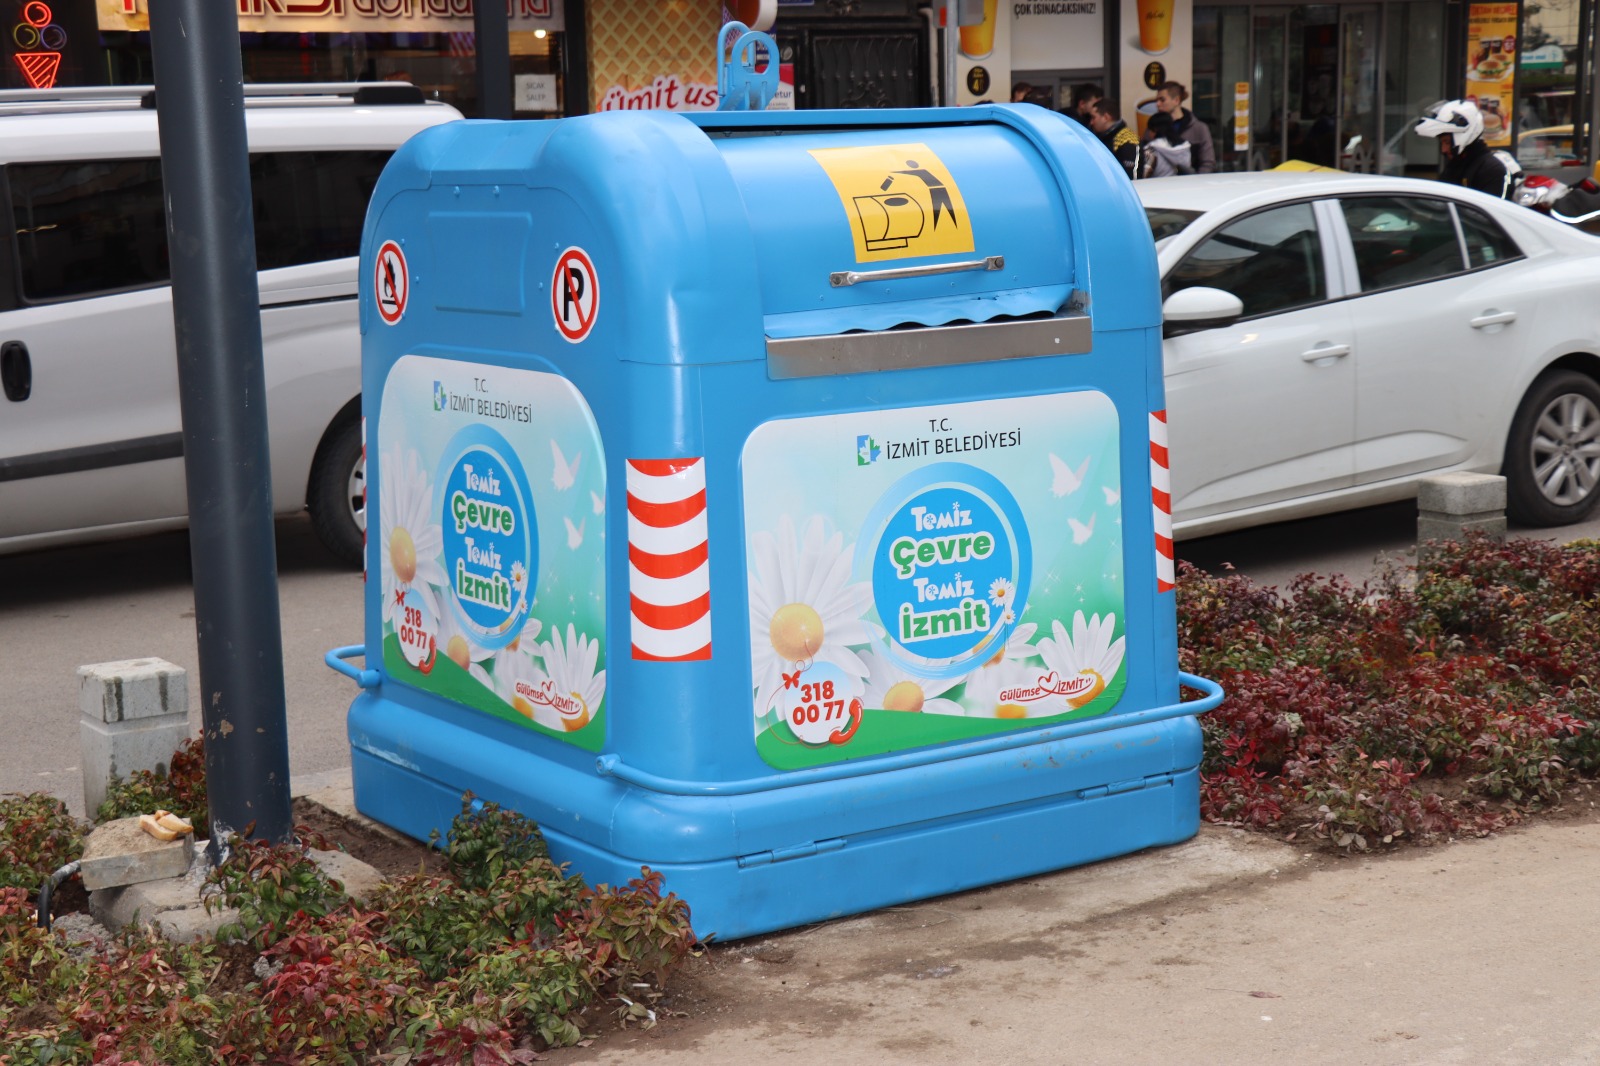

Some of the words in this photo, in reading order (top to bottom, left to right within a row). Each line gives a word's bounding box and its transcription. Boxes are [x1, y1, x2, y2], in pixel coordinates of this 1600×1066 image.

[1014, 3, 1032, 20] ÇOK
[773, 90, 792, 98] etur
[474, 377, 489, 393] T.C.
[449, 391, 475, 414] İZMİT
[477, 399, 532, 424] BELEDİYESİ
[929, 418, 953, 433] T.C.
[886, 437, 930, 460] İZMİT
[935, 427, 1022, 456] BELEDİYESİ
[463, 463, 502, 496] Temiz
[452, 493, 514, 532] Çevre
[910, 501, 973, 532] Temiz
[464, 536, 502, 571] Temiz
[892, 533, 992, 576] Çevre
[457, 560, 510, 610] İzmit
[913, 571, 975, 603] Temiz
[404, 606, 422, 628] 318
[902, 600, 988, 640] İzmit
[400, 624, 415, 645] 00
[415, 629, 428, 650] 77
[516, 682, 544, 701] Gülümse
[800, 680, 835, 704] 318
[999, 686, 1041, 702] Gülümse
[792, 703, 820, 726] 00
[823, 699, 845, 721] 77
